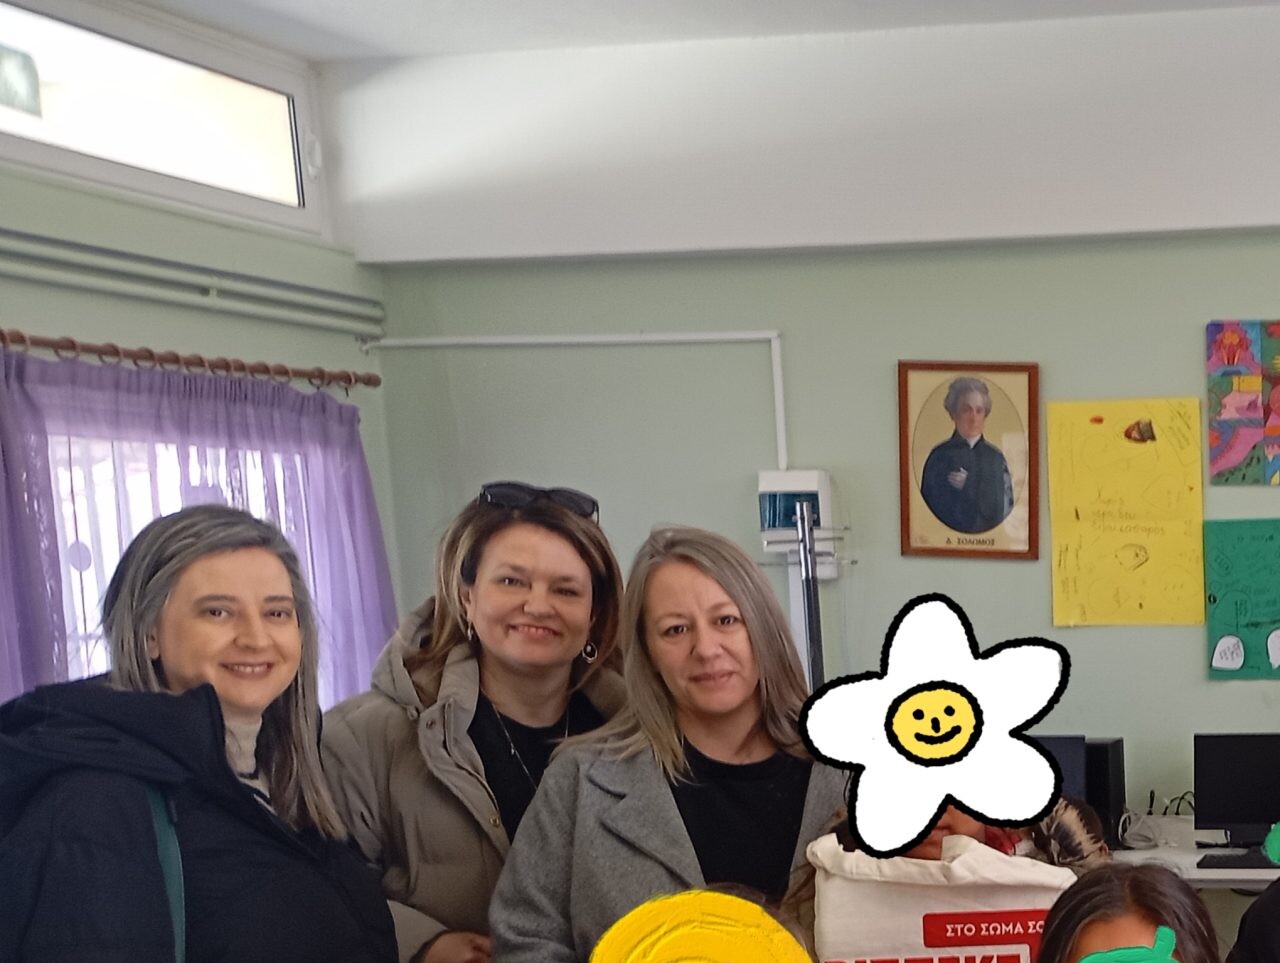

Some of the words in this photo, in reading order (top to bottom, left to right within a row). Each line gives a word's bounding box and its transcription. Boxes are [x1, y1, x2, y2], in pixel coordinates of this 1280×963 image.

[946, 924, 975, 937] ΣΤΟ
[980, 922, 1024, 936] ΣΩΜΑ
[1028, 920, 1044, 934] ΣΟ
